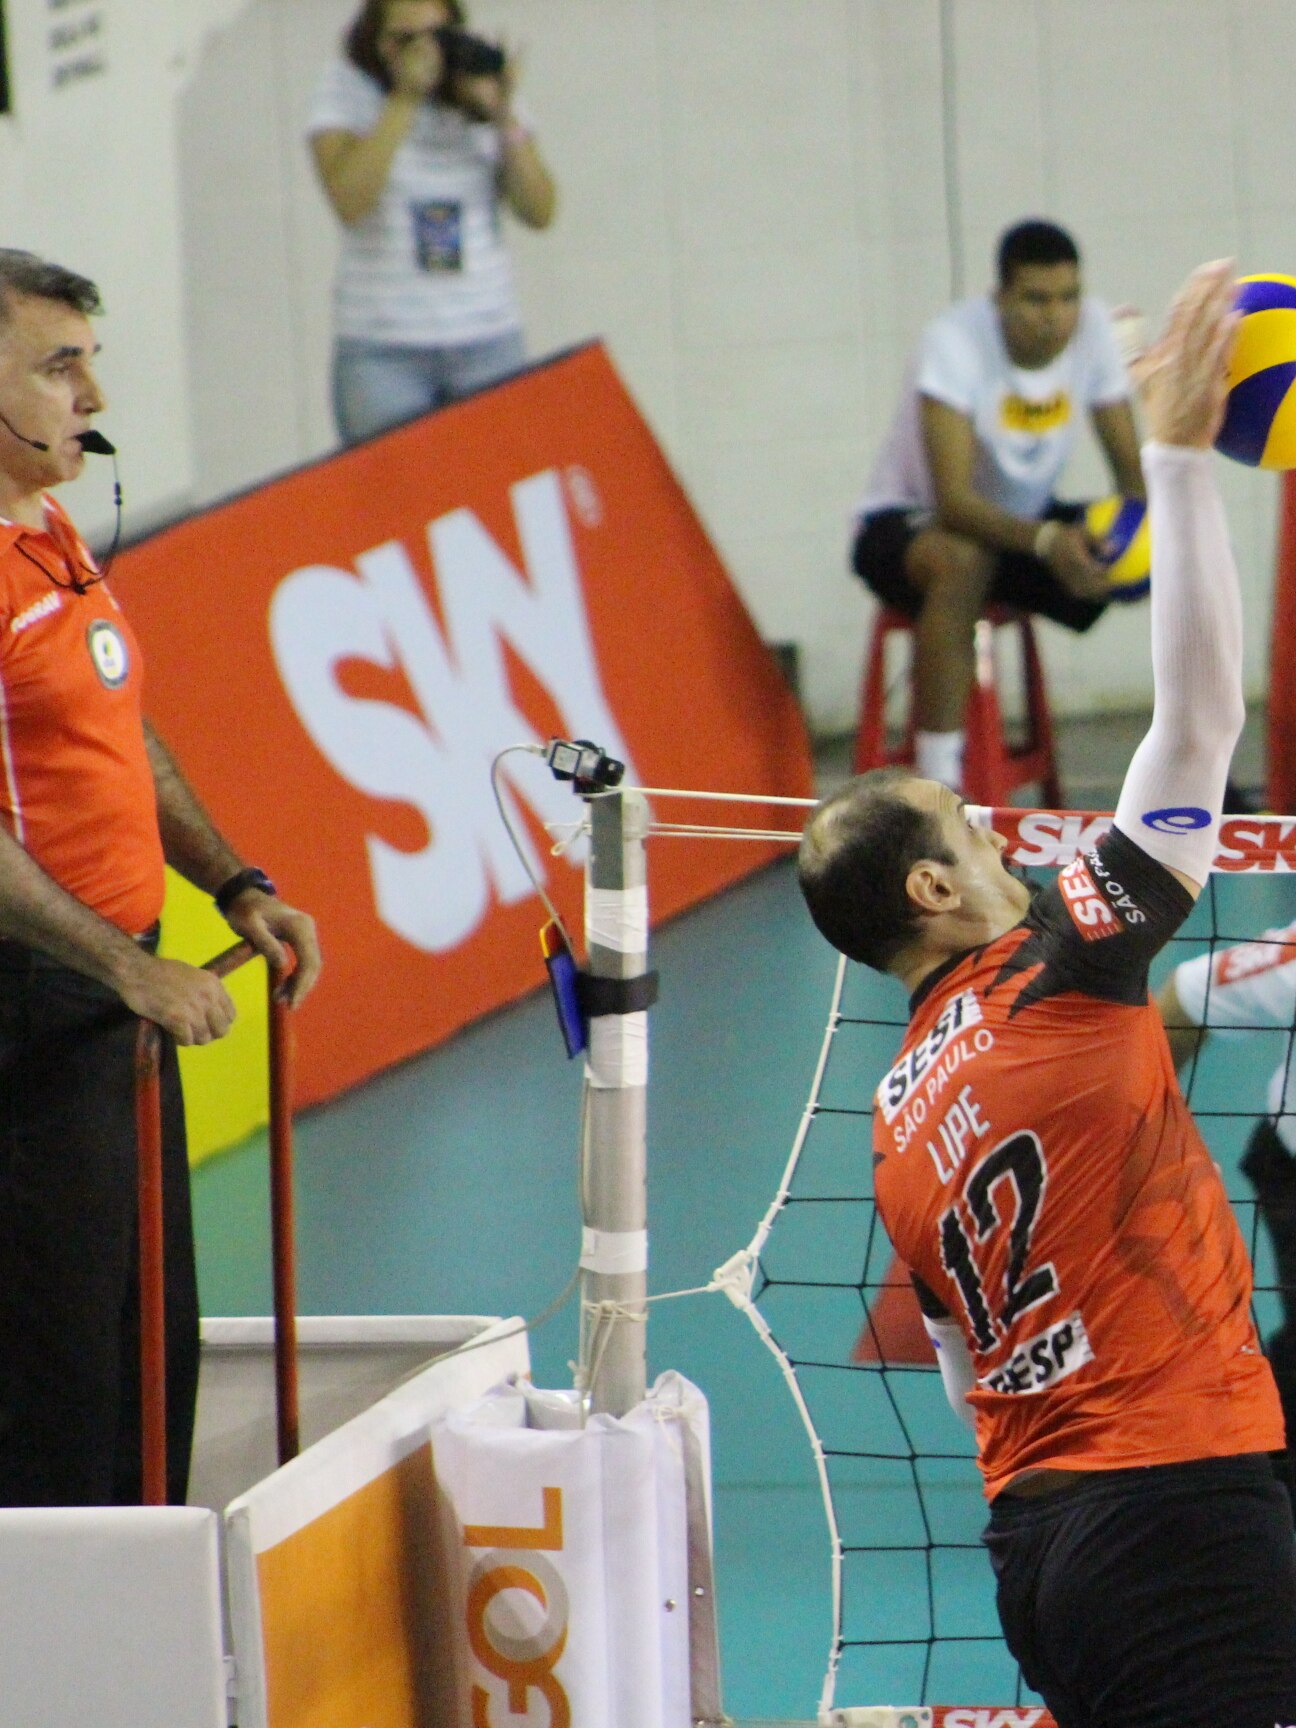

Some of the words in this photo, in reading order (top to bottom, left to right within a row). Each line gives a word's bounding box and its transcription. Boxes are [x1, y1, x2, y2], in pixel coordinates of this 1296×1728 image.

[269, 467, 656, 952] SKY
[1012, 813, 1115, 866] SK
[1106, 880, 1146, 924] SÃO
[889, 997, 964, 1107] SESI
[893, 1097, 927, 1153] SÃO
[926, 1028, 995, 1105] PAULO
[926, 1084, 991, 1185] LIPE
[938, 1129, 1060, 1354] 12
[463, 1486, 571, 1728] GOL
